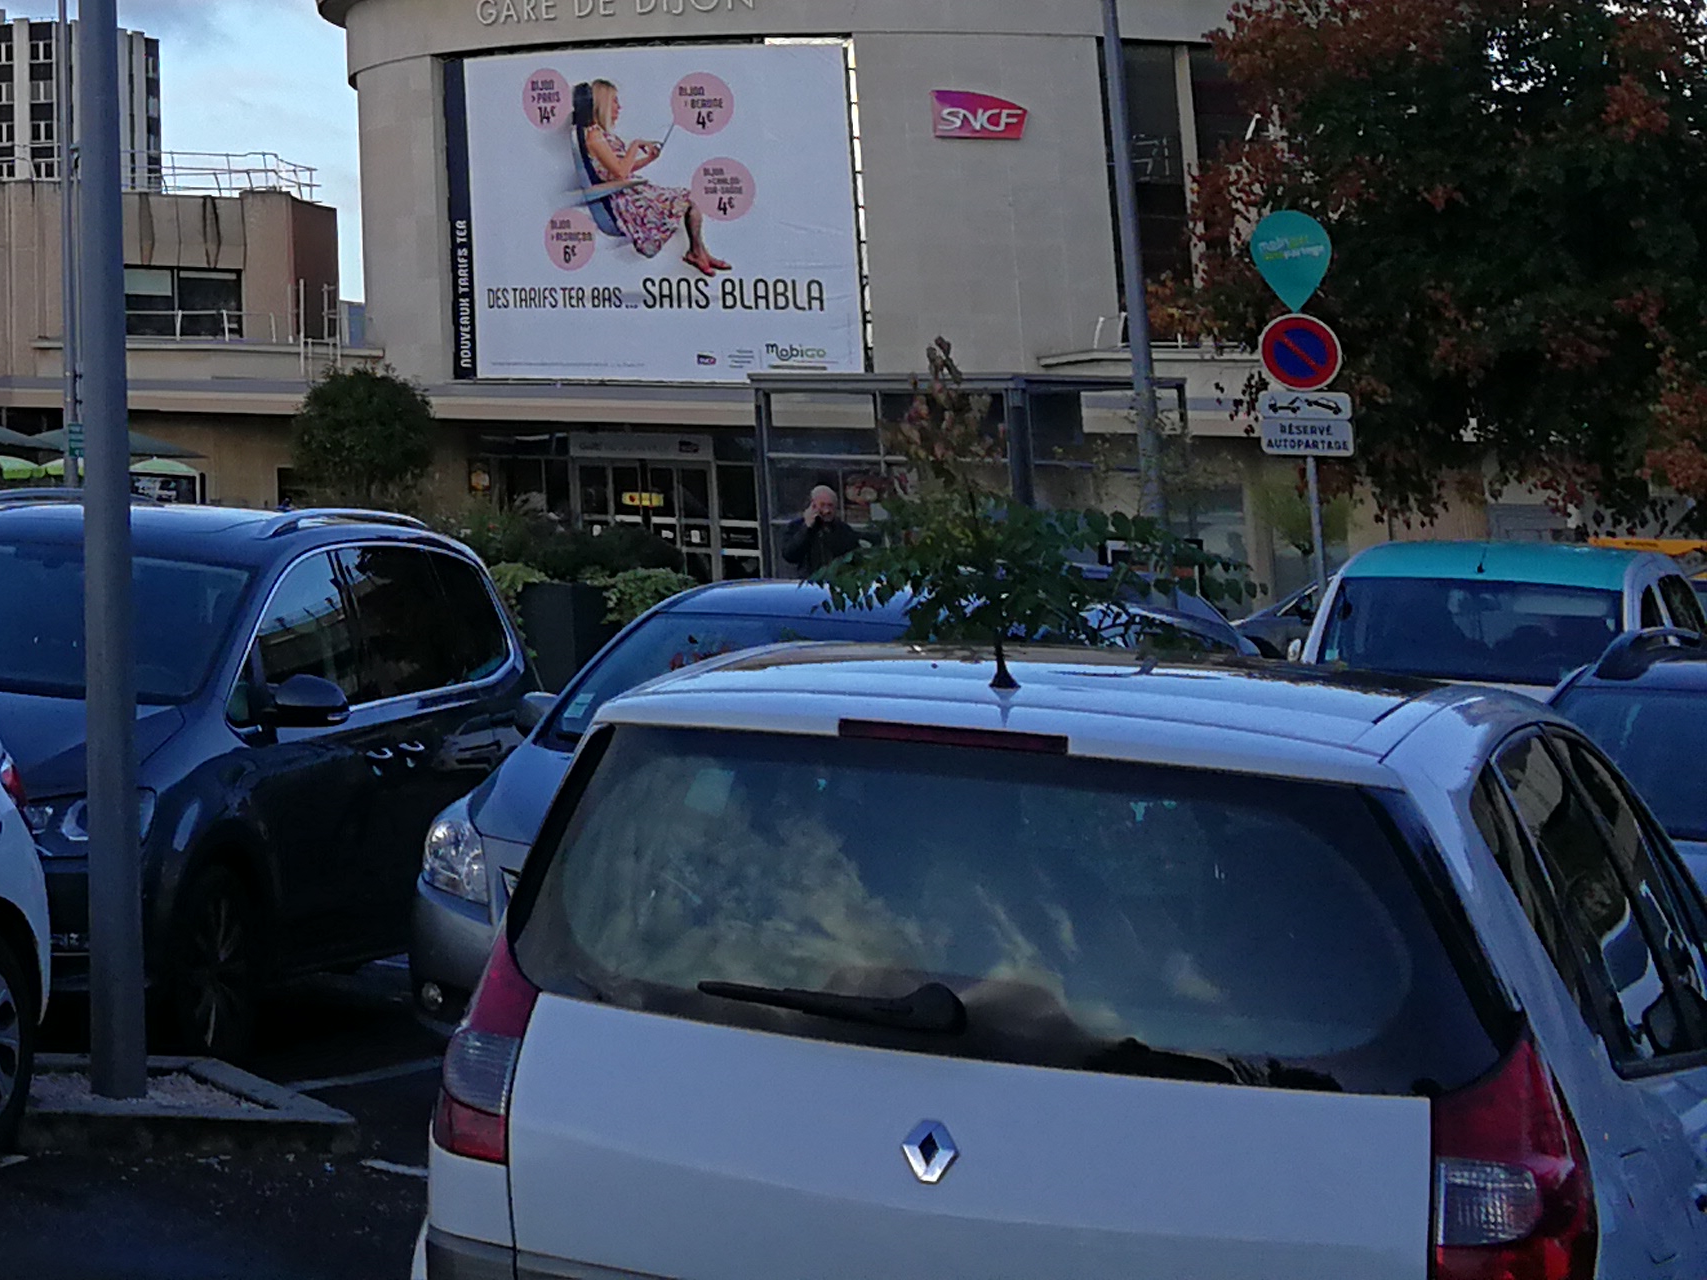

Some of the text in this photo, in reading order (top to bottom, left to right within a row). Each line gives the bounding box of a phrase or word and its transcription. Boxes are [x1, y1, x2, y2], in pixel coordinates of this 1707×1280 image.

[695, 110, 715, 130] 4€
[937, 107, 1023, 132] SNCF
[716, 196, 735, 216] 4€
[563, 245, 577, 264] 6€
[455, 220, 472, 368] NOUVEAUX TARIFS TER
[486, 287, 510, 309] DES
[511, 287, 558, 309] TARIFS
[561, 287, 586, 309] TER
[642, 277, 710, 310] SANS
[721, 278, 825, 312] BLABLA
[1267, 439, 1350, 451] AUTOPARTAGE
